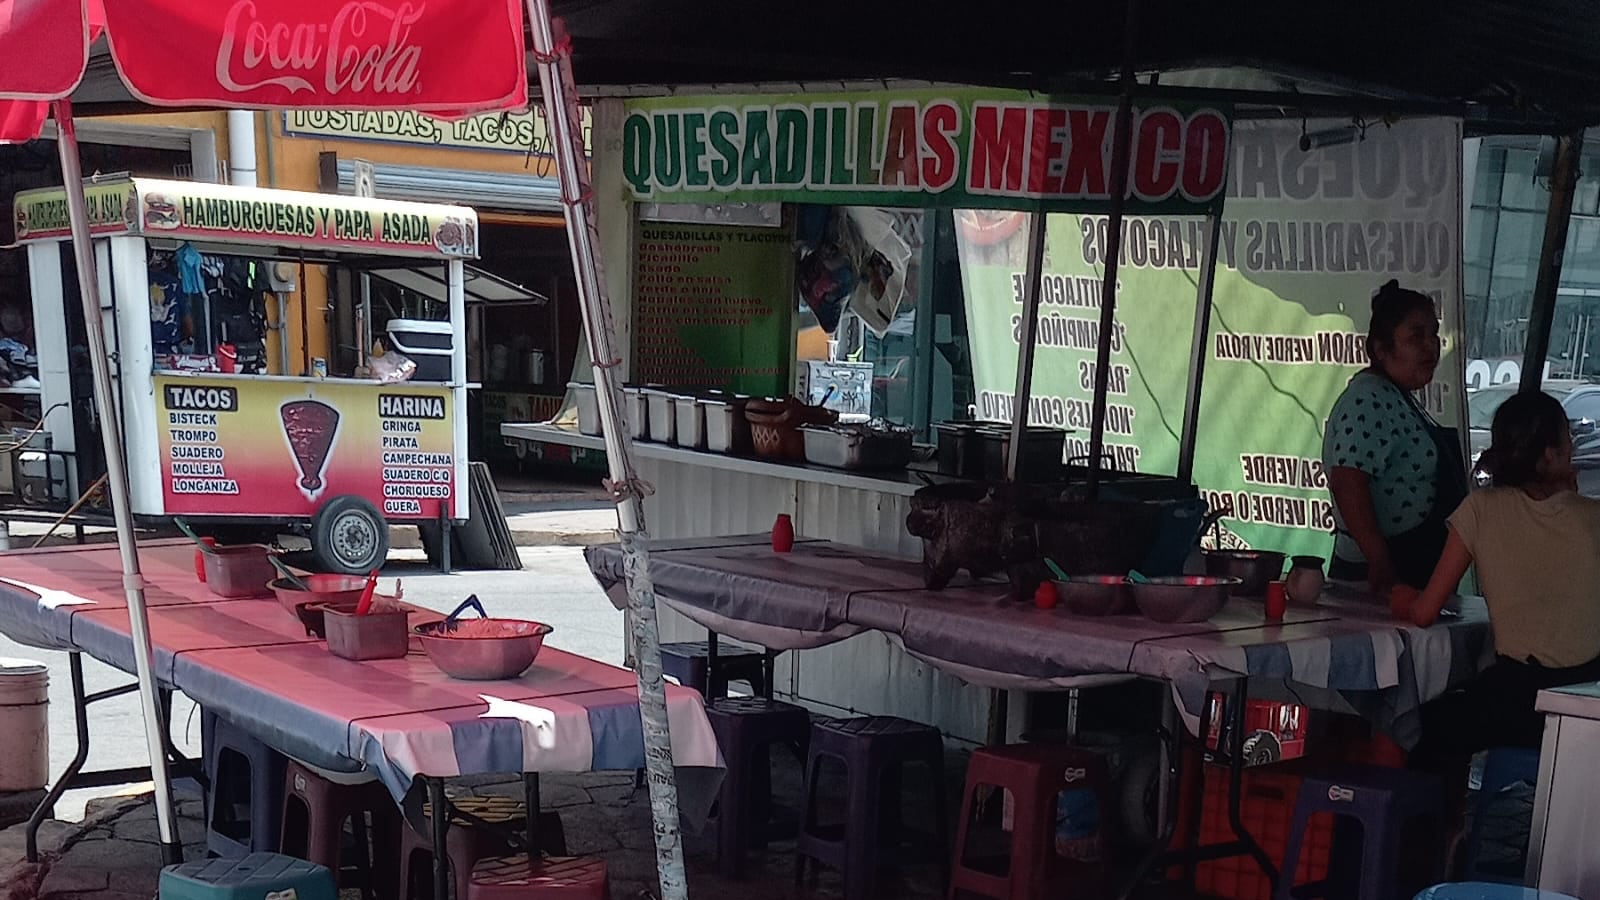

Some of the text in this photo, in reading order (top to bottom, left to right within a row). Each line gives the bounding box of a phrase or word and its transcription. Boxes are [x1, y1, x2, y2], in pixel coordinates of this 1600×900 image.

[216, 0, 425, 94] Coca-Cola
[452, 117, 540, 152] TACOS,
[623, 103, 957, 194] QUESADILLAS
[181, 196, 431, 244] HAMBURGUESAS Y PAPA ASADA
[642, 230, 722, 241] QUESADILLAS
[726, 232, 733, 241] Y
[170, 387, 231, 409] TACOS
[380, 396, 443, 417] HARINA
[169, 412, 217, 425] BISTECK
[382, 421, 421, 432] GRINGA
[170, 430, 217, 442] TROMPO
[382, 437, 418, 448] PIRATA
[171, 447, 223, 459] SUADERO
[383, 452, 451, 465] CAMPECHANA
[172, 463, 223, 475] MOLLEJA
[383, 469, 430, 480] SUADERO
[174, 480, 237, 492] LONGANIZA
[384, 485, 449, 496] CHORIQUESO
[385, 501, 419, 512] GUERA
